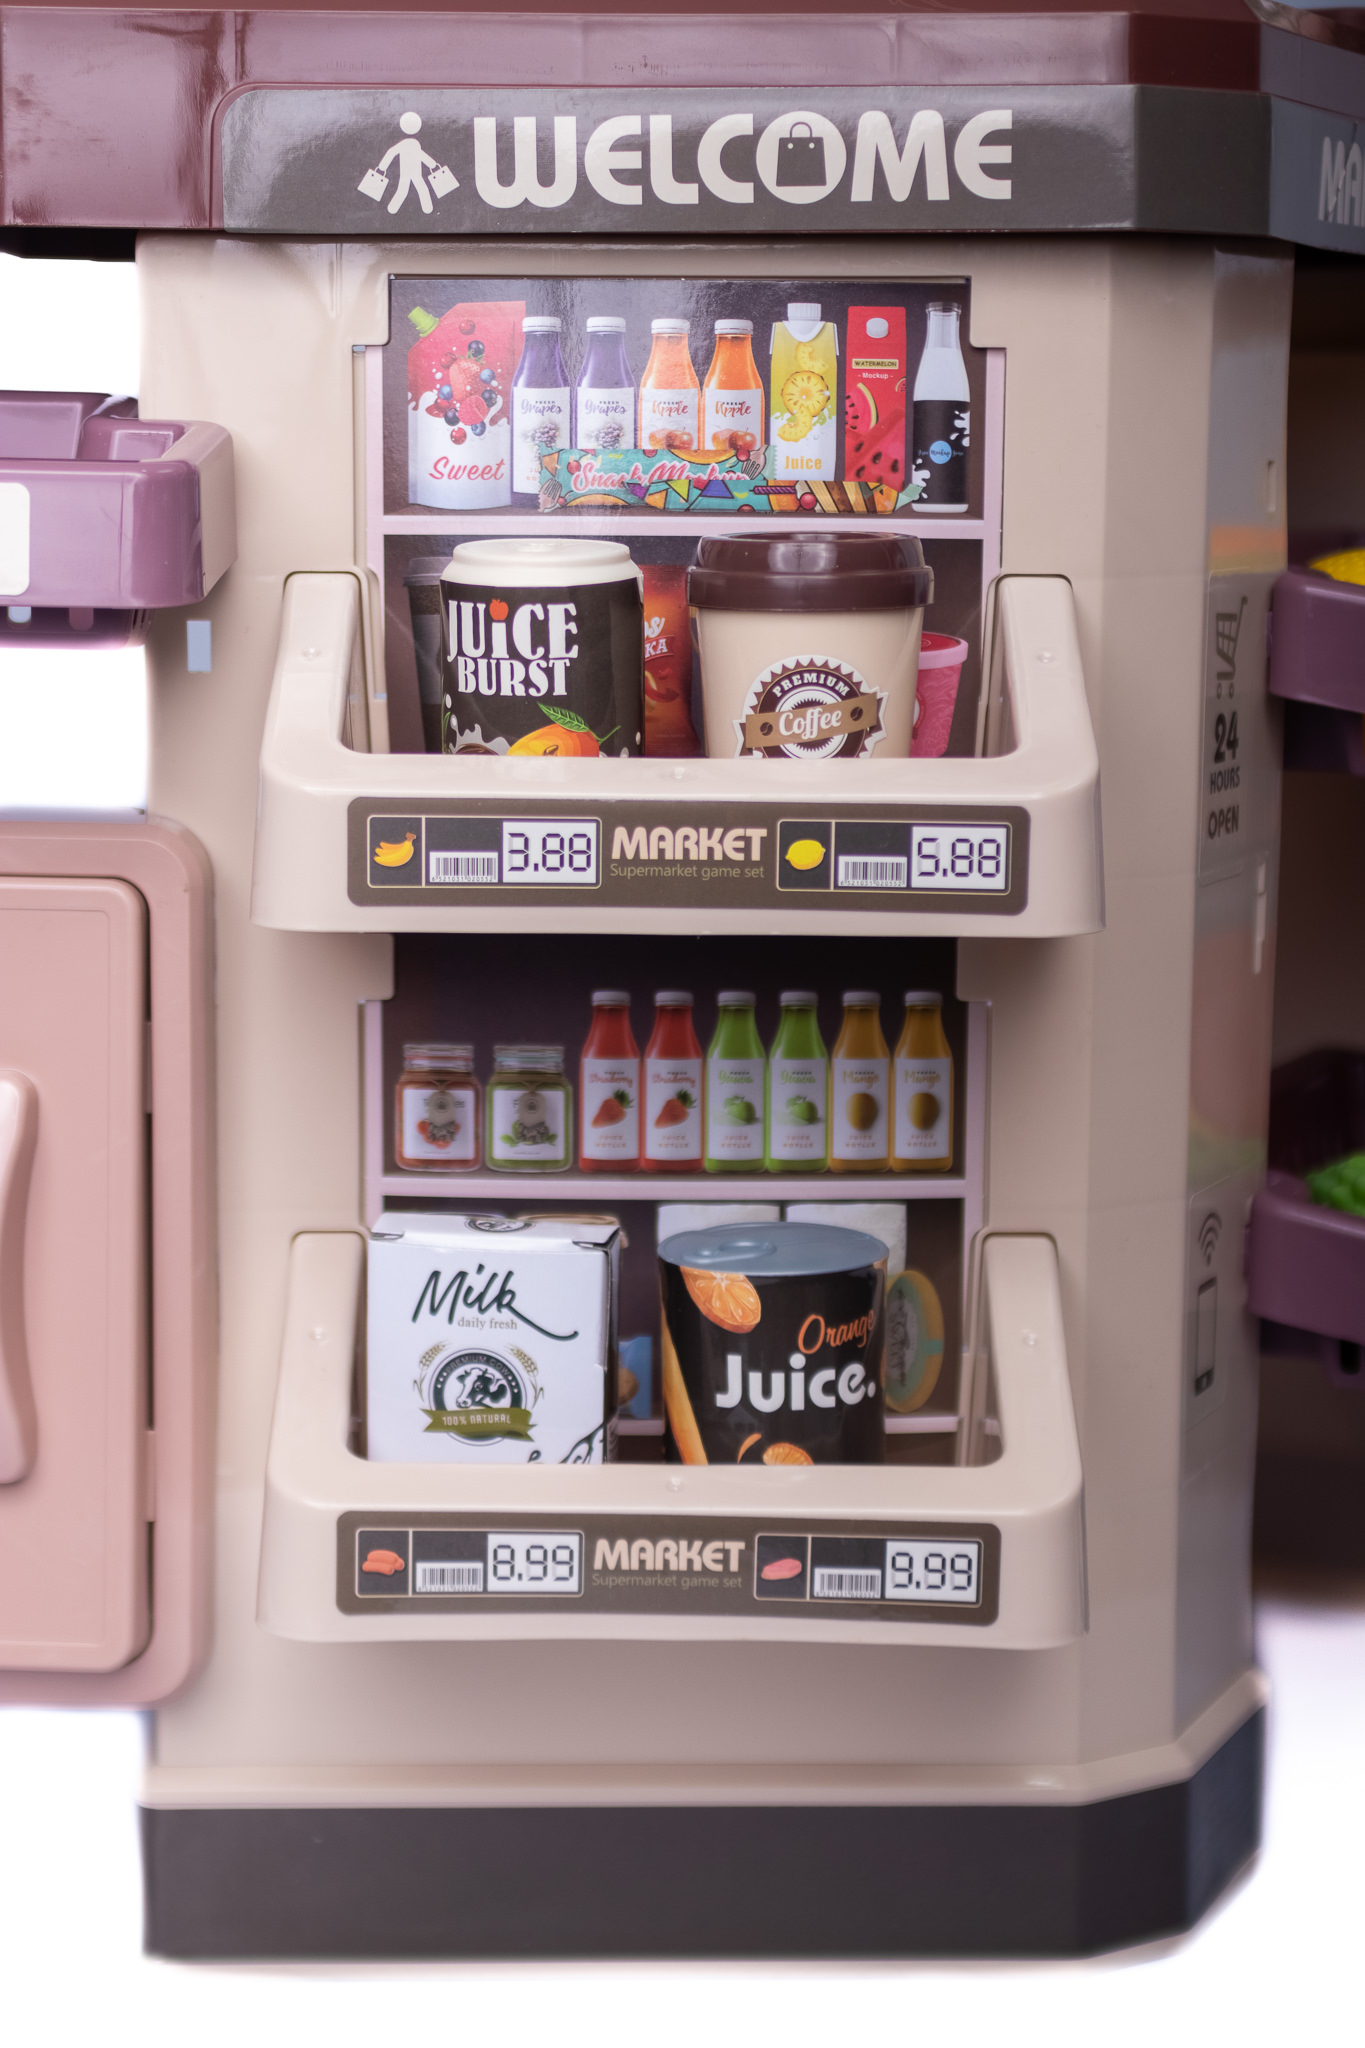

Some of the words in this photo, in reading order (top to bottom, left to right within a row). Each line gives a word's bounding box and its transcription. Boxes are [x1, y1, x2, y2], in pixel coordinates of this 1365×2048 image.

[474, 109, 1012, 208] WELCOME
[1318, 136, 1365, 227] MA
[715, 399, 752, 418] Apple
[428, 456, 507, 481] Sweet
[784, 455, 822, 470] Juice
[457, 655, 571, 697] BURST
[772, 672, 850, 698] PREMIUM
[778, 705, 842, 740] Coffee
[1214, 711, 1239, 764] 24
[1210, 767, 1240, 794] HOURS
[1207, 805, 1240, 841] OPEN
[507, 832, 592, 873] 3.88
[611, 826, 767, 861] MARKET
[917, 838, 1001, 878] 5.88
[610, 863, 698, 880] Supermarket
[701, 867, 741, 881] game
[744, 866, 765, 879] set
[411, 1262, 579, 1341] Milk
[457, 1317, 485, 1331] daily
[489, 1317, 518, 1330] fresh
[798, 1310, 875, 1354] Orange
[446, 1355, 487, 1374] PREMIUM
[490, 1358, 511, 1376] COW
[442, 1415, 467, 1426] 100%
[492, 1544, 574, 1581] 8.99
[594, 1539, 746, 1573] MARKET
[891, 1552, 973, 1590] 9.99
[592, 1573, 678, 1589] Supermarket
[681, 1576, 719, 1590] game
[722, 1576, 743, 1589] set
